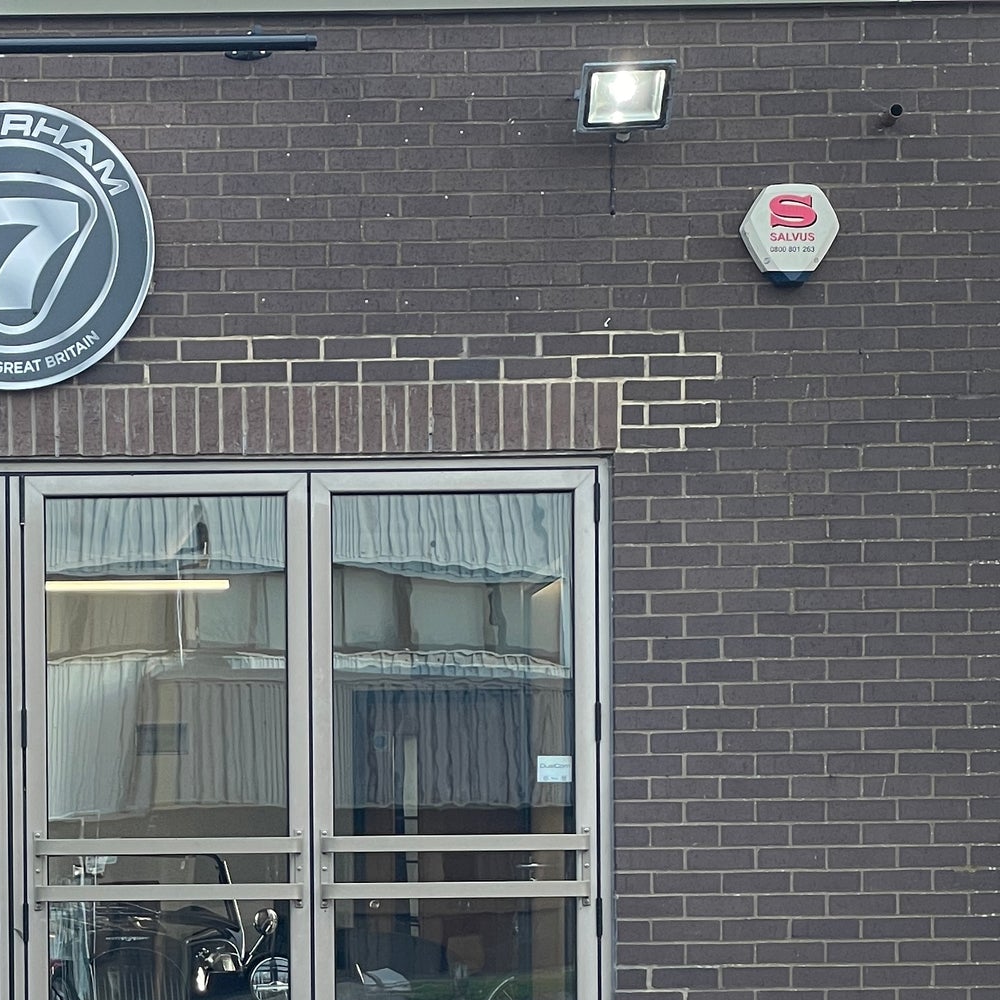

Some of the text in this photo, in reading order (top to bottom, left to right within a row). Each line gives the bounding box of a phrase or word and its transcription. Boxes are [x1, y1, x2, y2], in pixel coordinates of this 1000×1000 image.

[769, 232, 816, 242] SALVUS
[769, 245, 787, 253] 0800
[788, 245, 801, 253] 801
[45, 329, 101, 369] BRITAIN
